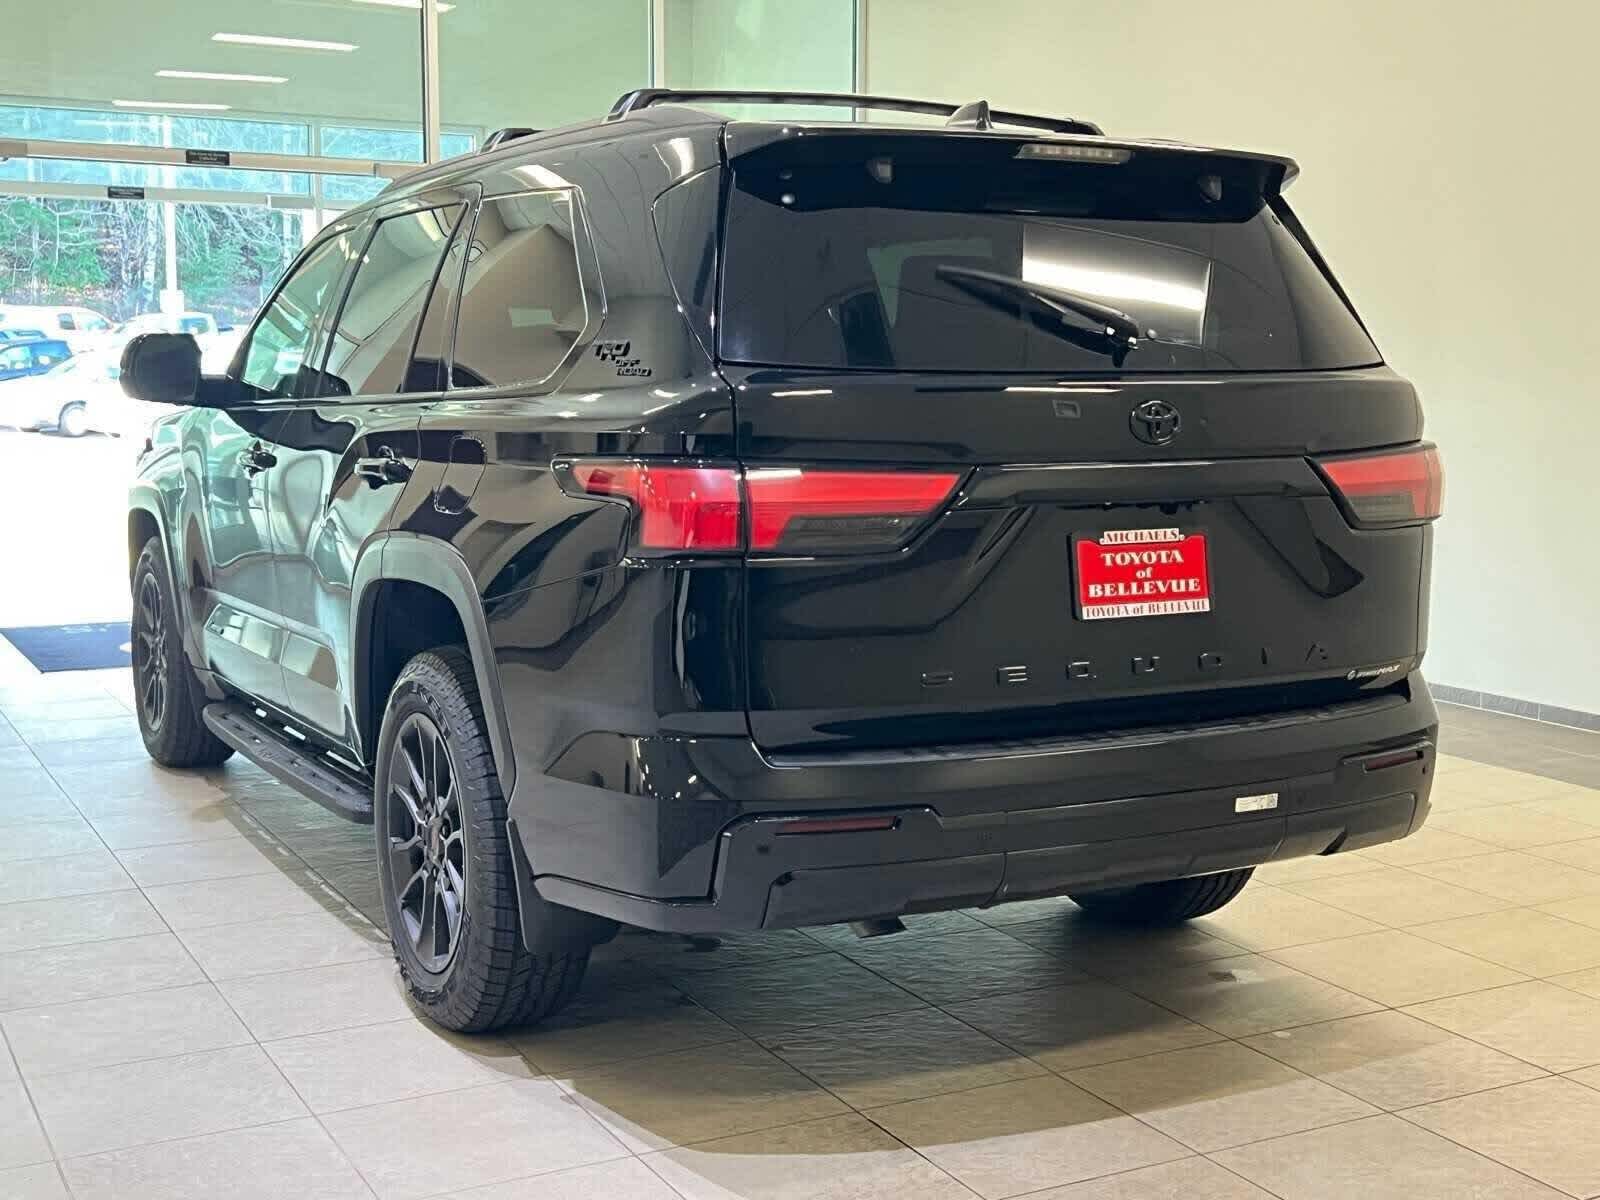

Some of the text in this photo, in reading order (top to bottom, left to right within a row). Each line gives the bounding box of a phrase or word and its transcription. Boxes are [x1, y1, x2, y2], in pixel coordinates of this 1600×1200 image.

[1105, 529, 1179, 544] MICHAELS
[1101, 550, 1184, 567] TOYOTA
[1135, 567, 1153, 579] of
[1088, 578, 1200, 598] BELLEVUE
[1086, 599, 1206, 619] TOYOTA of BELLEVUE
